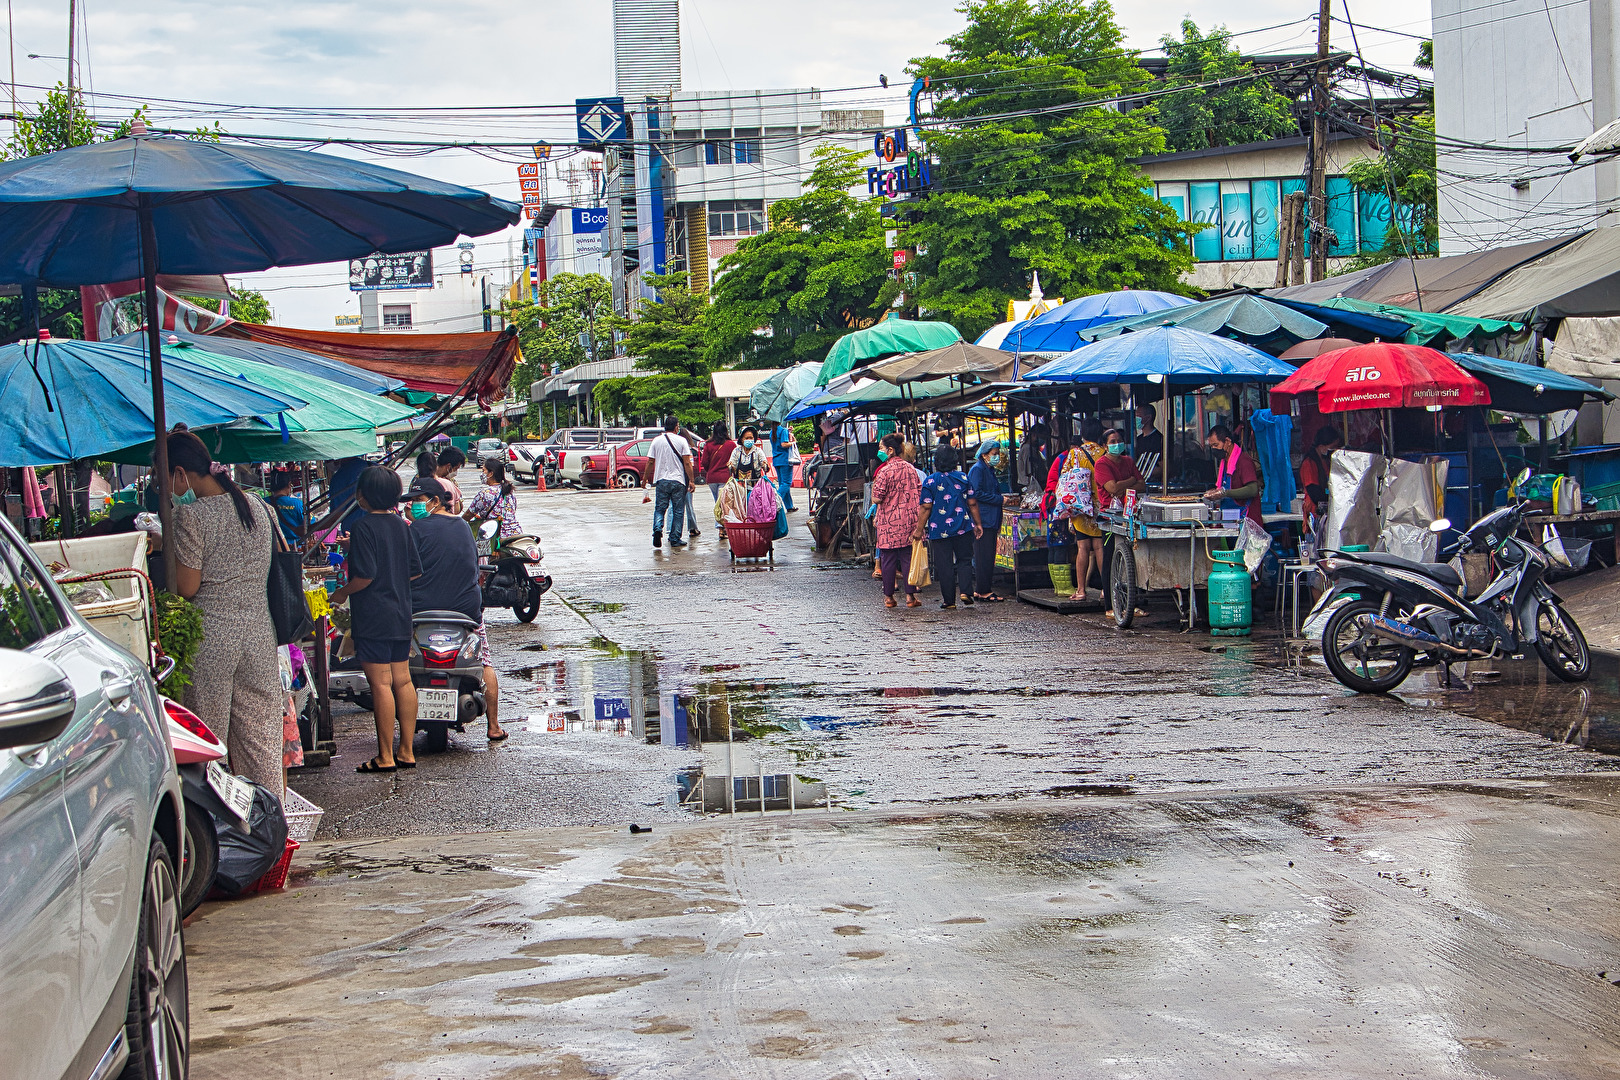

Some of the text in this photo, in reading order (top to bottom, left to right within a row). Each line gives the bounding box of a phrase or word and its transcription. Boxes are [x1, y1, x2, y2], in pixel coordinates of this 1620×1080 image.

[1345, 366, 1381, 382] ลีโอ
[1333, 393, 1390, 403] www.iloveleo.net
[423, 710, 450, 719] 1924
